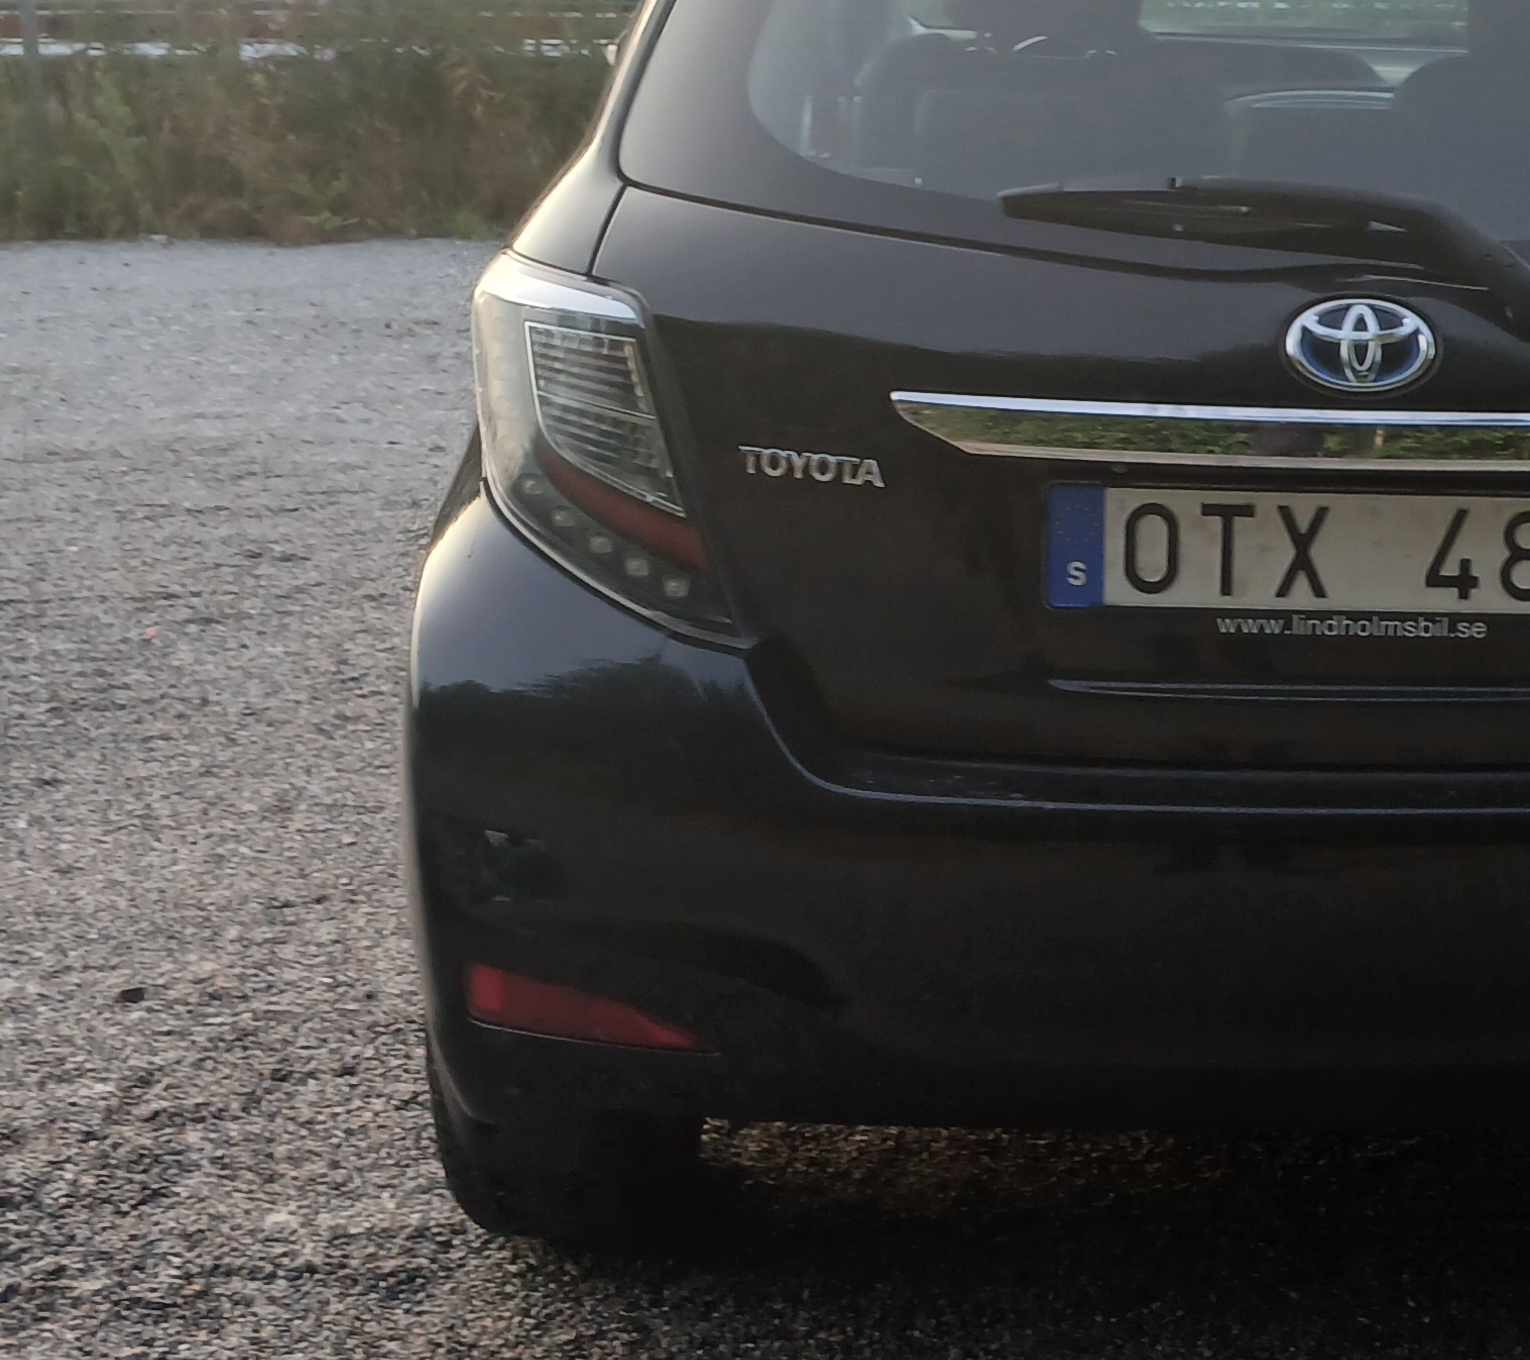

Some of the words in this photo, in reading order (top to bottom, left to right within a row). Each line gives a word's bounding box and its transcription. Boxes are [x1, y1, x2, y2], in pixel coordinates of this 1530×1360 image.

[738, 445, 885, 488] TOYOTA
[1123, 502, 1330, 599] OTX
[1066, 560, 1088, 587] S
[1216, 614, 1488, 640] www.lindholmsbil.se
